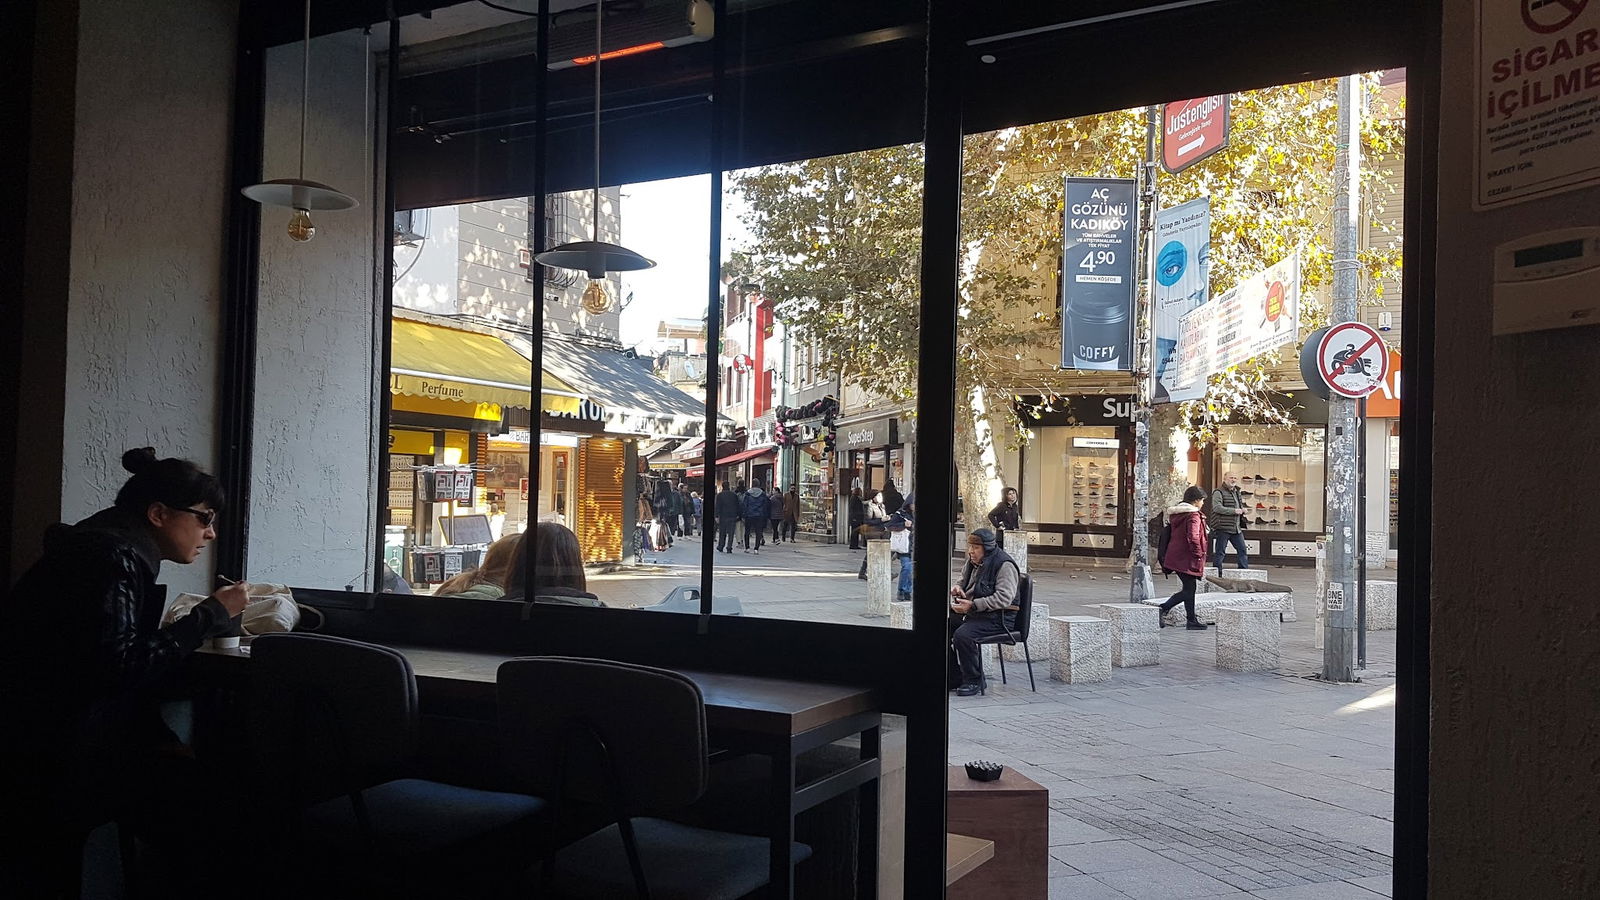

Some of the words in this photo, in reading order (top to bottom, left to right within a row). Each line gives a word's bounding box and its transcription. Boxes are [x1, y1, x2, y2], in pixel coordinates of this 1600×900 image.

[1090, 188, 1110, 202] AÇ
[1071, 202, 1128, 216] GÖZÜNÜ
[1071, 217, 1128, 231] KADIKÖY
[1079, 251, 1115, 272] 4.90
[1079, 345, 1115, 360] COFFY
[421, 381, 464, 398] Perfume
[848, 428, 874, 445] SuperStep
